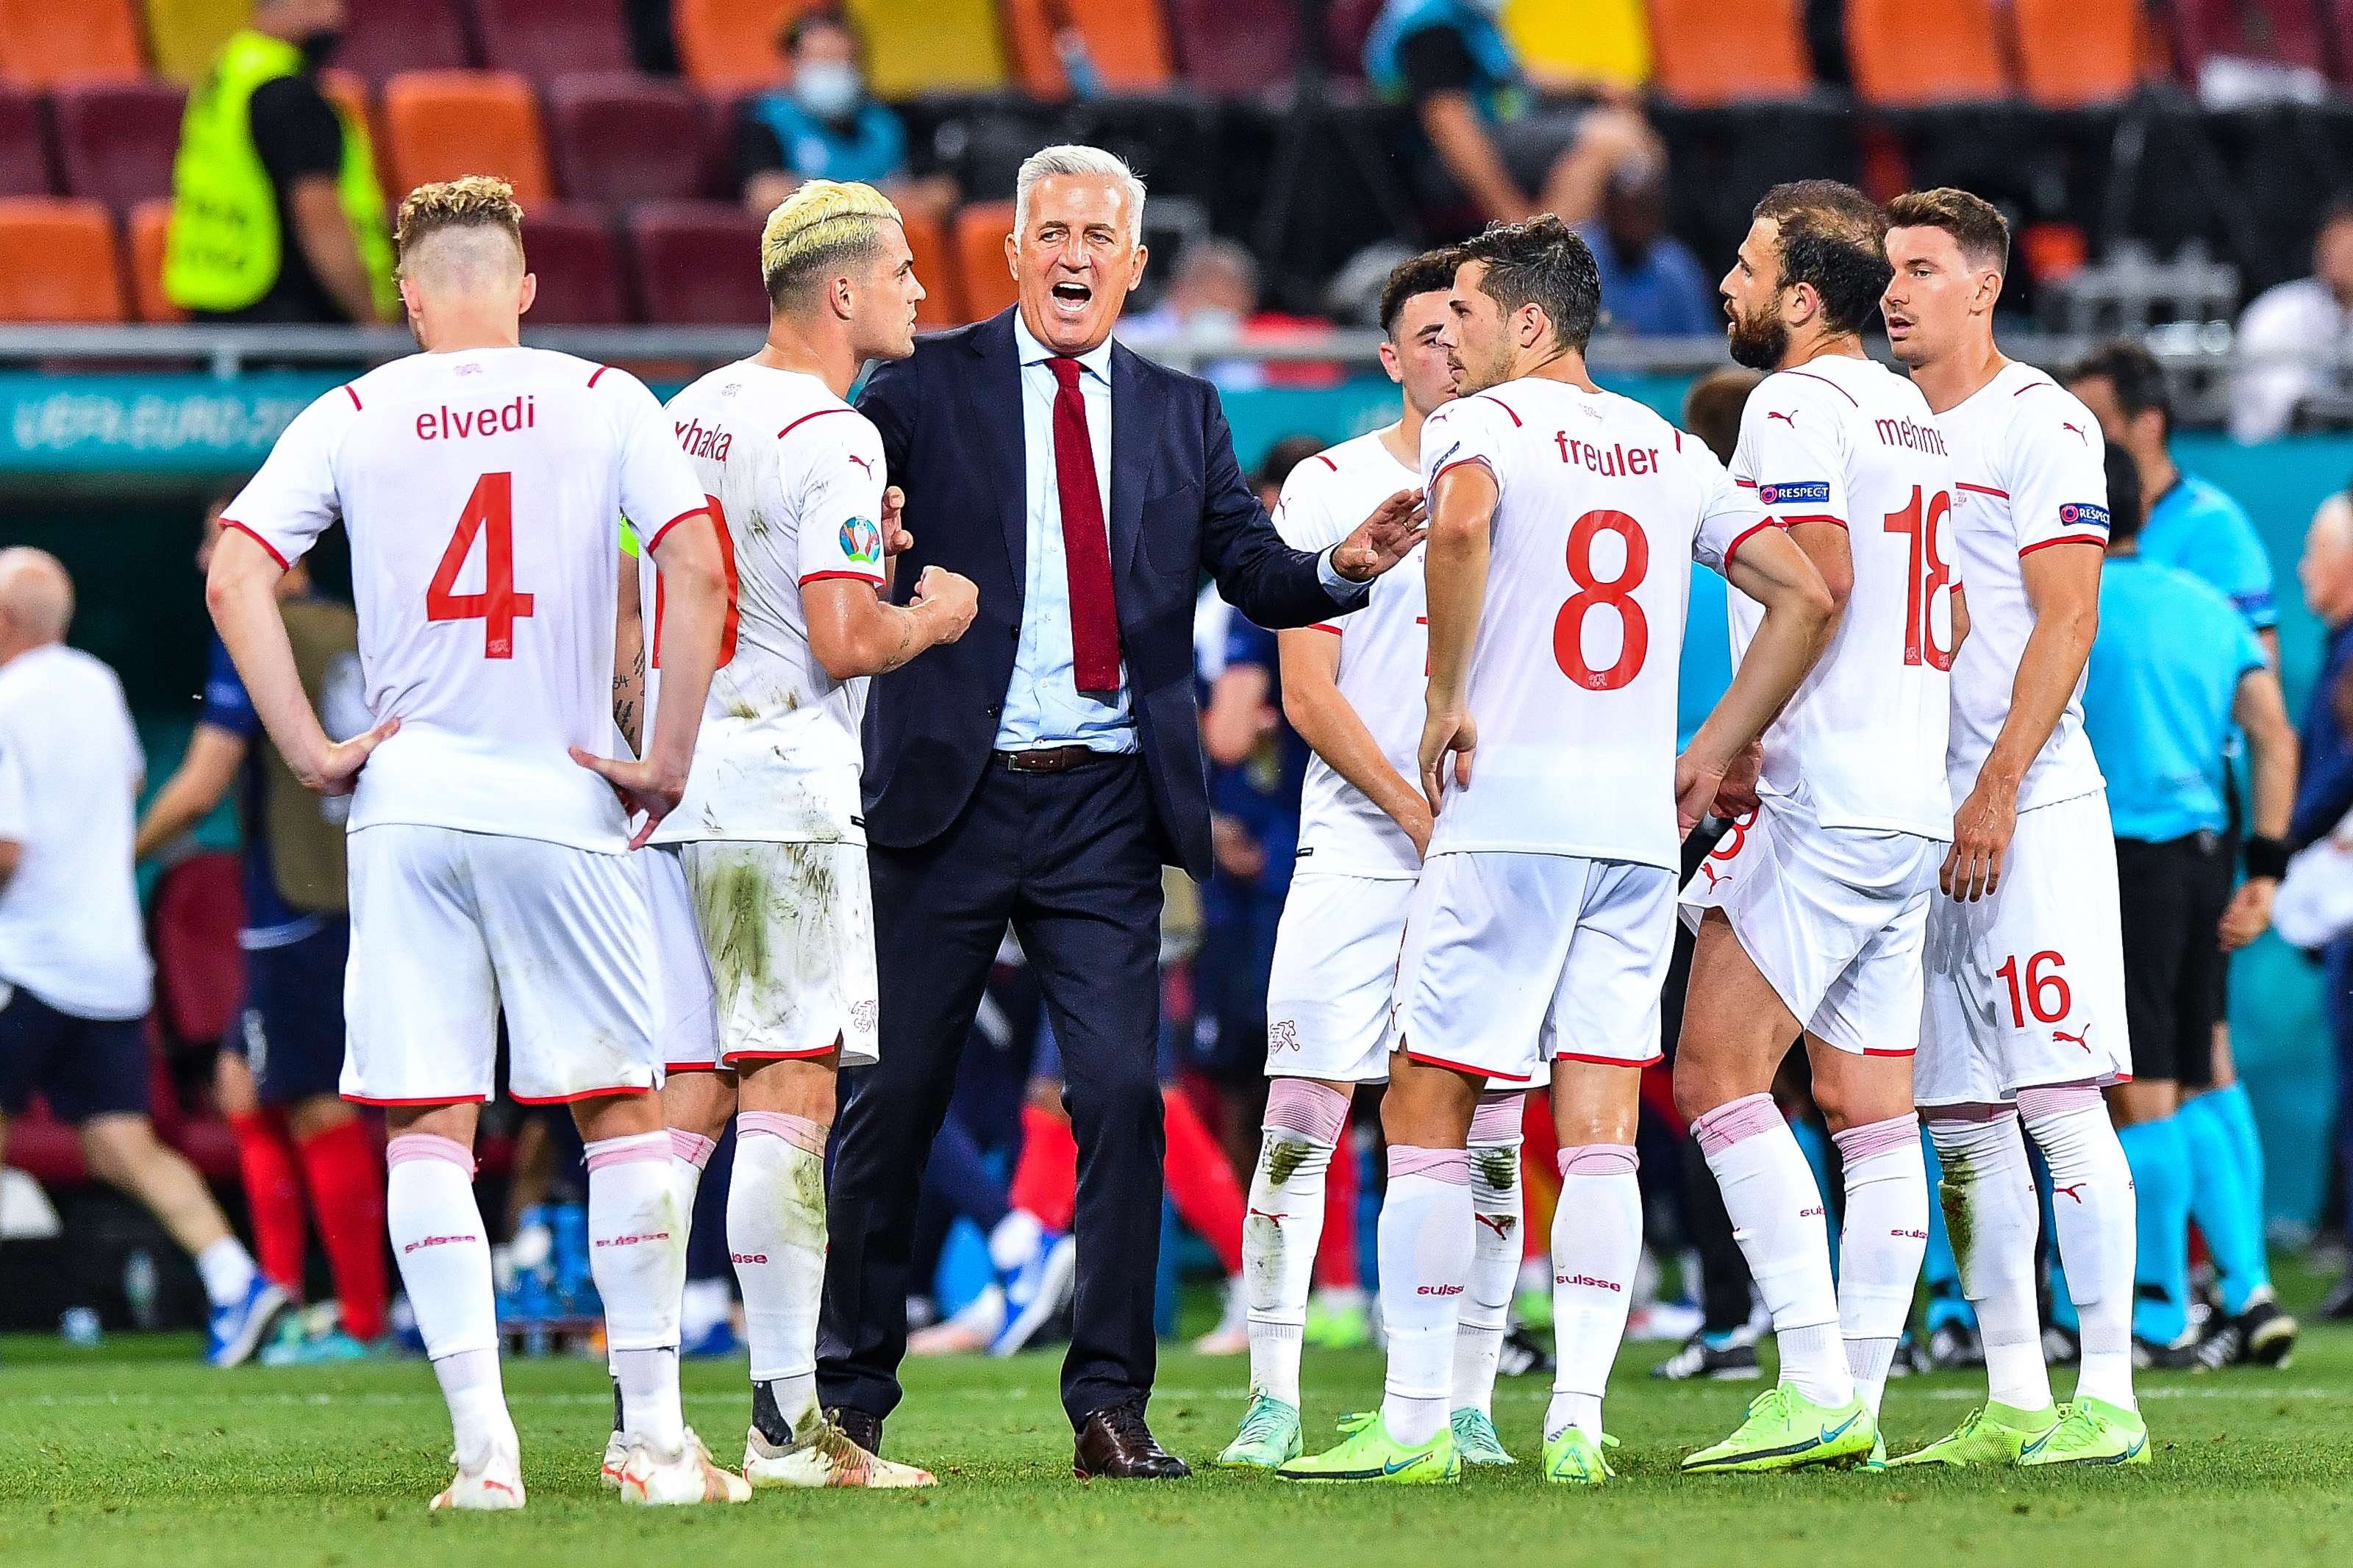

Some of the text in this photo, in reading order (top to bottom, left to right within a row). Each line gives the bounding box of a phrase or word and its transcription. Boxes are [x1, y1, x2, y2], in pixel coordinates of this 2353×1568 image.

[416, 395, 534, 440] elvedi
[1554, 430, 1659, 476] freuler
[1779, 487, 1829, 498] RESPECT
[426, 472, 534, 659] 4
[1884, 485, 1952, 672] 18
[1554, 510, 1649, 690] 8
[1996, 951, 2071, 1028] 16
[1556, 1274, 1621, 1292] suisse
